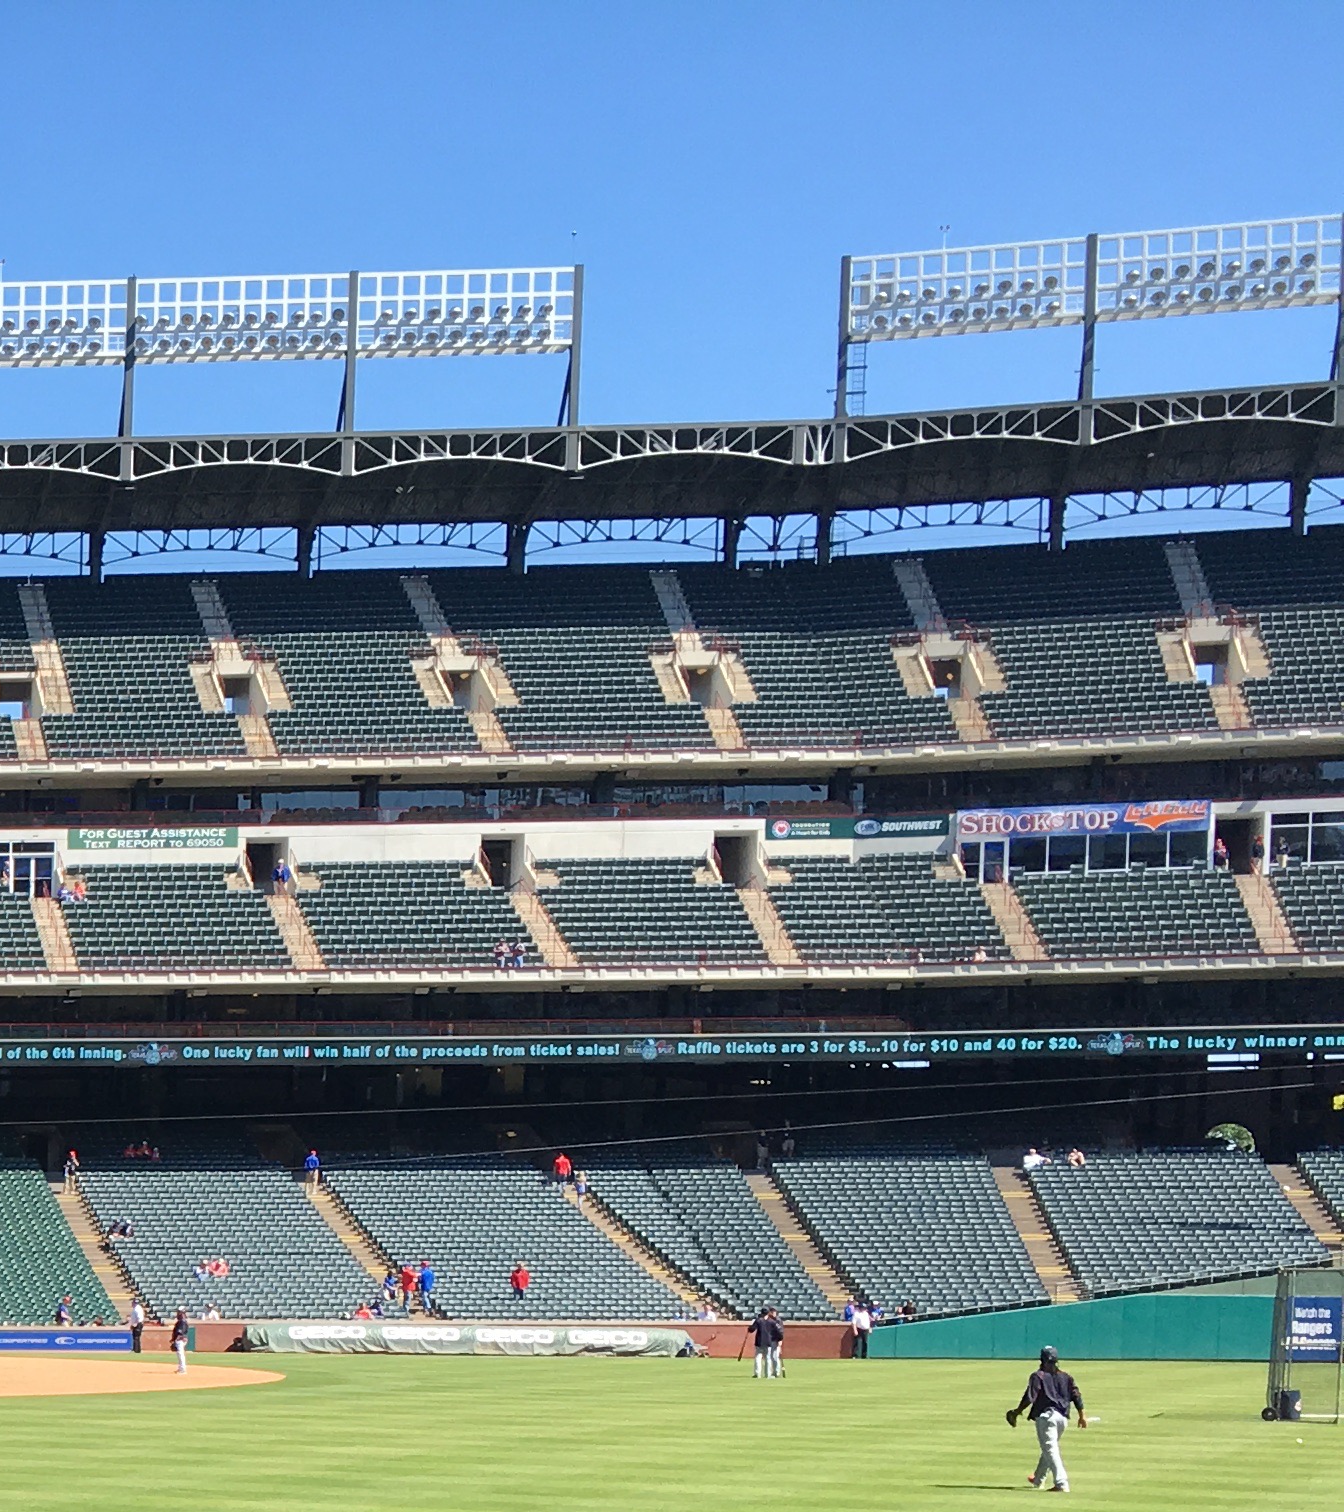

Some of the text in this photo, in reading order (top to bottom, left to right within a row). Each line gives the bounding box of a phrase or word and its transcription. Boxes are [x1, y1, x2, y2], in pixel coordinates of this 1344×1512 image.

[881, 819, 943, 832] SOUTHWEST
[961, 810, 1119, 834] SHOCK TOP
[117, 839, 166, 849] REPORT
[186, 838, 225, 847] 69050
[677, 1041, 721, 1055] Raffle
[725, 1041, 777, 1054] tickets
[780, 1043, 806, 1054] are
[809, 1040, 819, 1053] 3
[823, 1040, 845, 1053] for
[902, 1039, 926, 1053] for
[930, 1038, 959, 1053] $10
[963, 1038, 992, 1052] and
[996, 1037, 1016, 1051] 40
[1020, 1037, 1045, 1051] for
[1048, 1036, 1083, 1051] $20.
[1146, 1036, 1180, 1050] The
[1187, 1035, 1237, 1051] lucky
[1243, 1034, 1308, 1048] winner
[6, 1046, 22, 1060] of
[25, 1047, 49, 1060] the
[52, 1046, 76, 1059] 6th
[79, 1046, 127, 1062] inning.
[182, 1046, 211, 1059] One
[214, 1045, 253, 1061] lucky
[256, 1045, 279, 1058] fan
[282, 1045, 309, 1058] will
[313, 1045, 339, 1058] win
[342, 1045, 372, 1058] half
[375, 1045, 391, 1058] of
[394, 1045, 418, 1058] the
[422, 1044, 488, 1060] proceeds
[492, 1044, 526, 1057] from
[529, 1043, 573, 1057] ticket
[289, 1325, 367, 1340] GEICO
[382, 1326, 461, 1341] GEICO
[475, 1327, 554, 1343] GEICO
[1292, 1320, 1333, 1337] Rangers
[568, 1330, 648, 1345] GEICO
